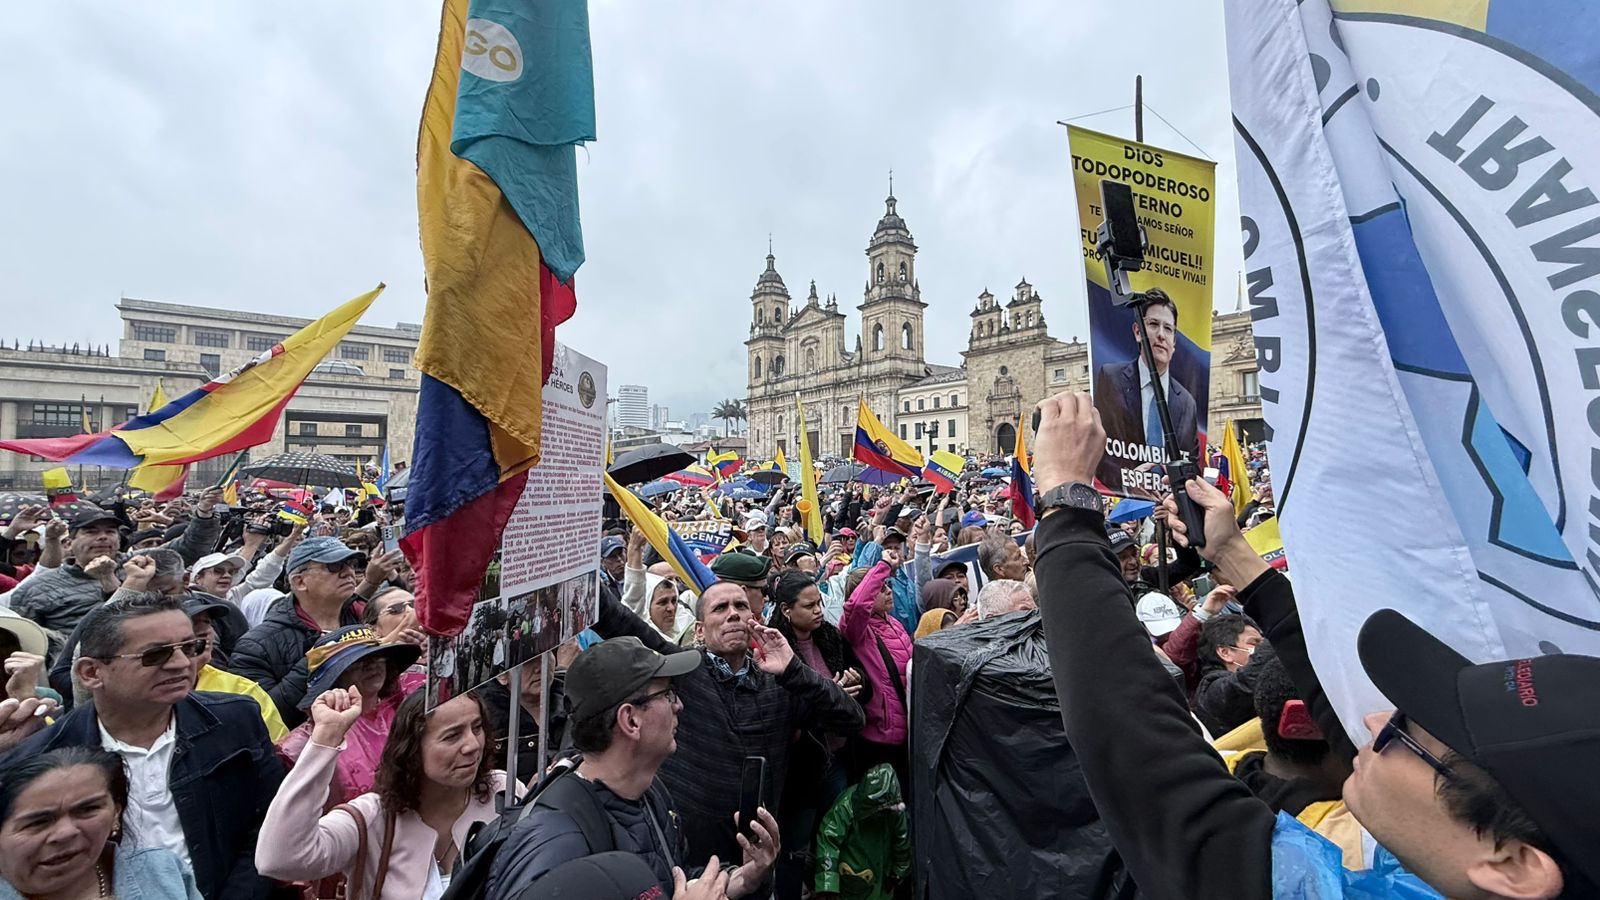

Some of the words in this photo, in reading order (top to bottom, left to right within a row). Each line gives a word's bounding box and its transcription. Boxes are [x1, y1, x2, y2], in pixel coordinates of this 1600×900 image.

[1124, 146, 1164, 168] DIOS
[1072, 154, 1210, 202] TODOPODEROSO
[1132, 193, 1182, 218] TERNO
[1089, 204, 1102, 216] TE
[1138, 216, 1162, 230] AMOS
[1164, 222, 1194, 239] SEÑOR
[1081, 228, 1098, 245] FU
[1144, 244, 1203, 270] MIGUEL!!
[1083, 248, 1102, 263] ORQ
[1140, 261, 1152, 272] OZ
[1155, 263, 1180, 279] SIGUE
[1182, 270, 1206, 285] VIVA!!
[1121, 468, 1172, 492] ESPERA
[681, 533, 728, 546] OCENTE
[339, 628, 372, 642] #UR
